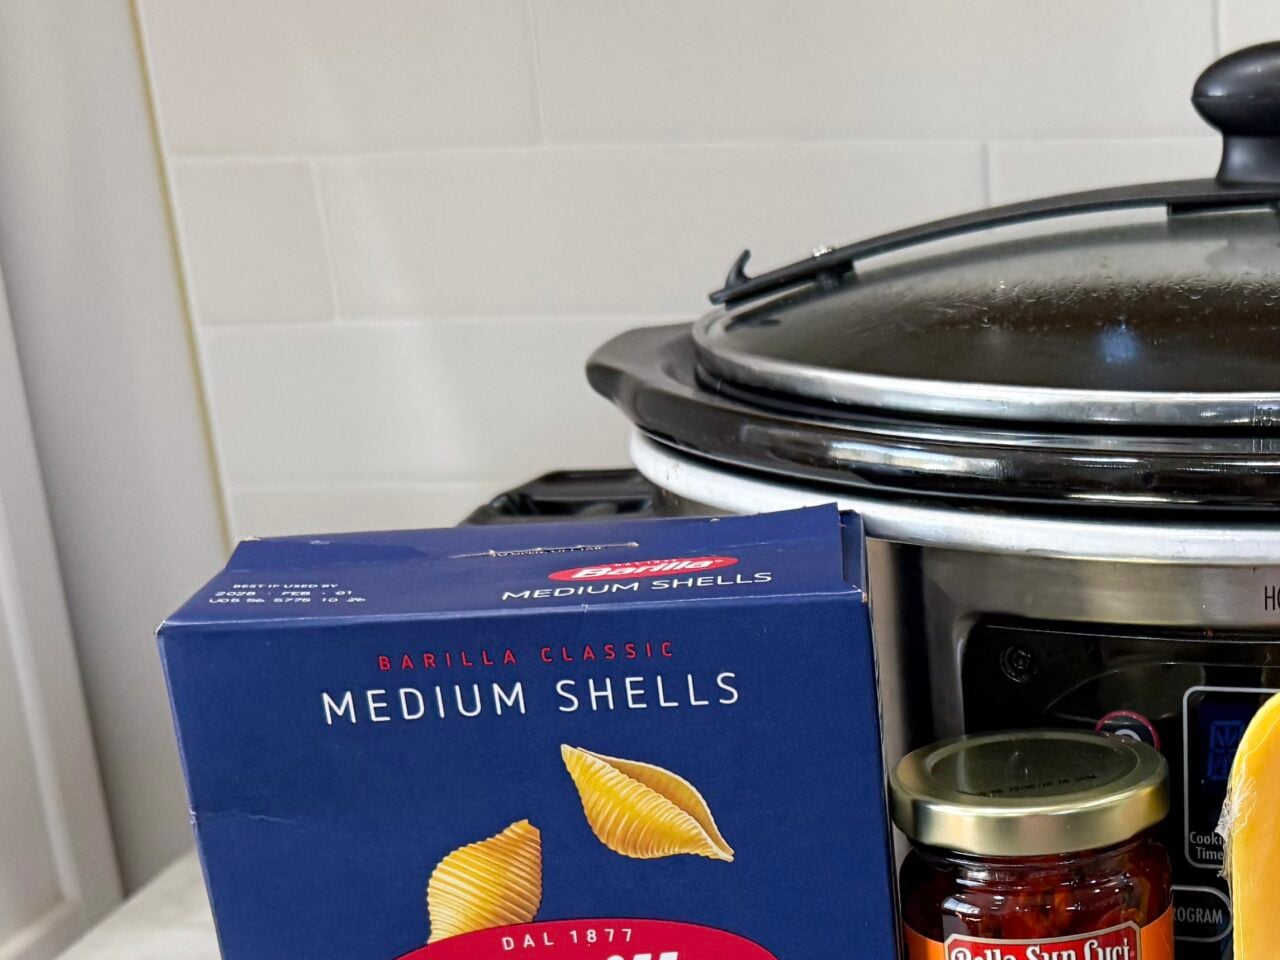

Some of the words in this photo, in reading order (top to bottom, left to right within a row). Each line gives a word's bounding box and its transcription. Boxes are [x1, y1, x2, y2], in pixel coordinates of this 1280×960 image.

[502, 582, 639, 601] MEDIUM
[651, 572, 772, 590] SHELLS
[377, 649, 518, 672] BARILLA
[540, 641, 674, 662] CLASSIC
[322, 681, 526, 725] MEDIUM
[556, 672, 740, 711] SHELLS
[502, 932, 555, 951] DAL
[570, 928, 634, 945] 1877
